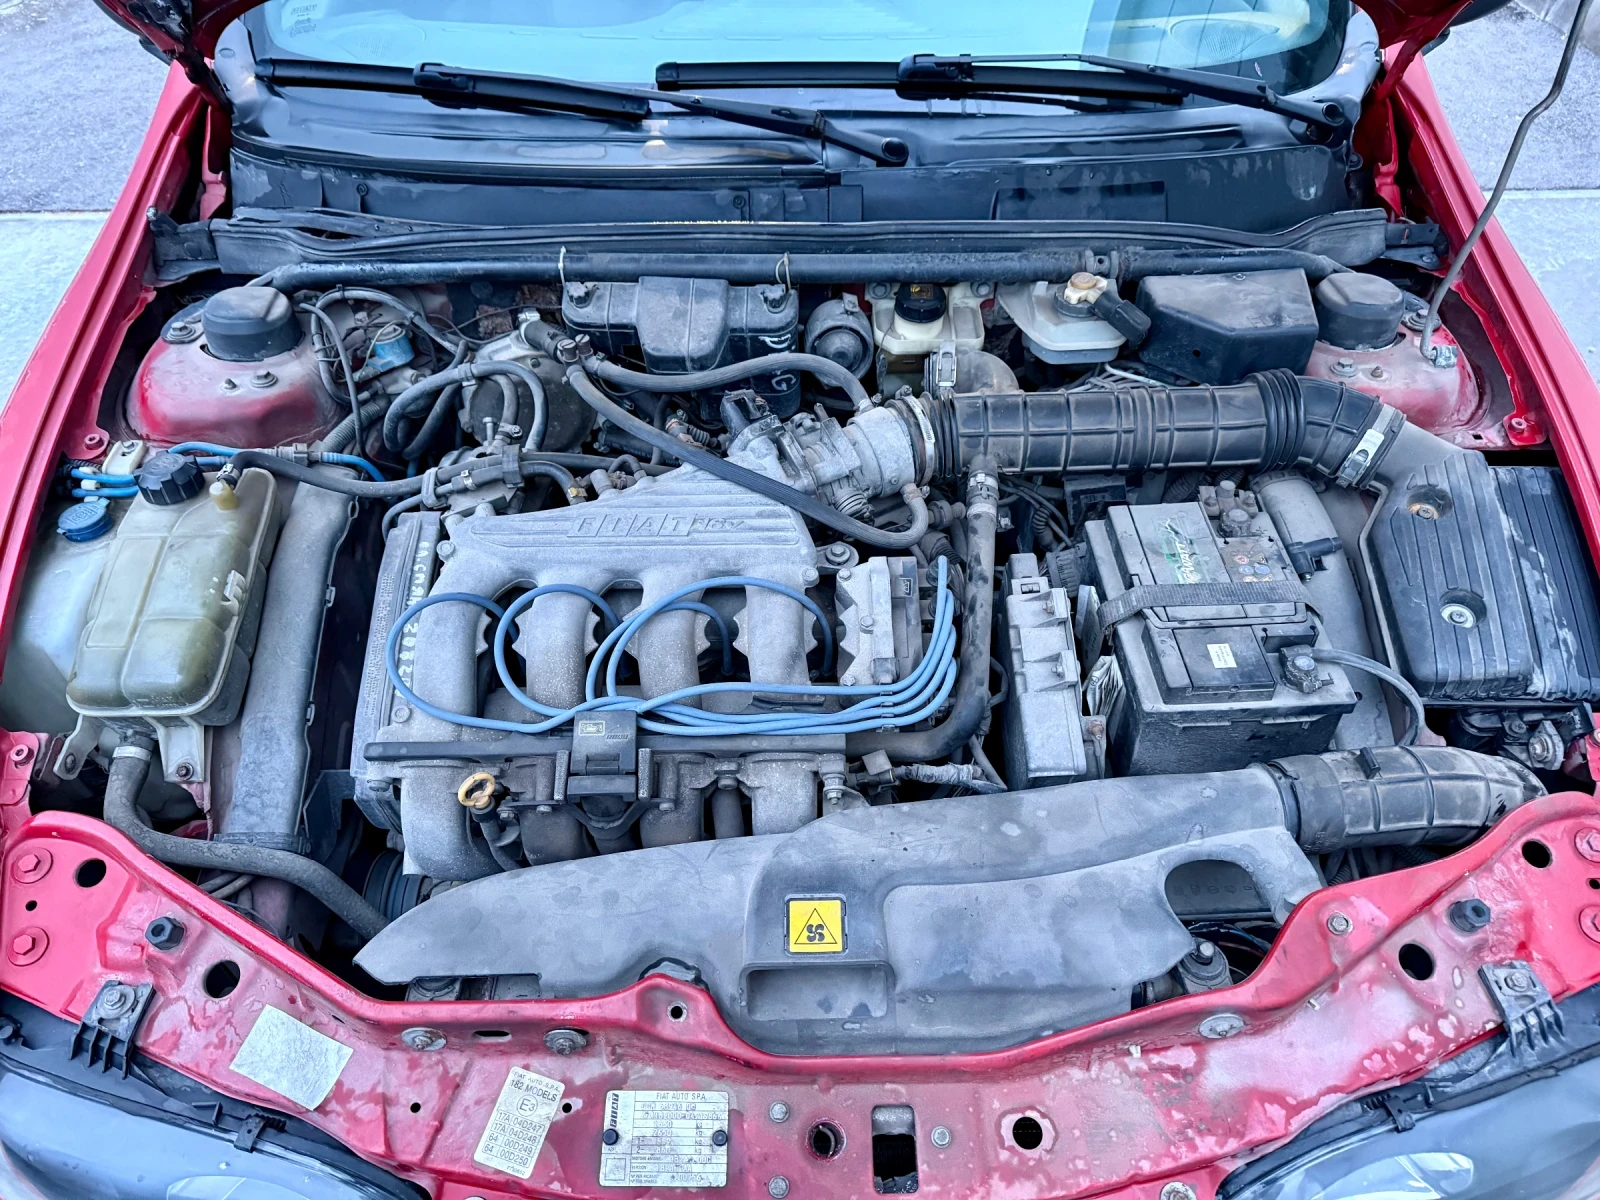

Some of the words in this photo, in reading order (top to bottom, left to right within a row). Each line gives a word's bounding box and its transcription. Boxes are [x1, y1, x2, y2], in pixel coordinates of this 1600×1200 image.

[574, 516, 692, 534] FIAT
[514, 1071, 526, 1079] FIAT
[528, 1077, 543, 1085] AUTO
[510, 1079, 524, 1090] 182
[524, 1083, 558, 1102] MODELS
[519, 1098, 536, 1112] E3
[609, 1093, 619, 1128] FIAT
[494, 1122, 506, 1134] 17A
[509, 1128, 537, 1143] 04D248
[499, 1112, 510, 1123] 17A
[513, 1118, 542, 1133] 04D247
[488, 1133, 498, 1142] 64
[504, 1138, 533, 1154] 00D249
[484, 1144, 494, 1153] 64
[500, 1149, 529, 1165] 00D250
